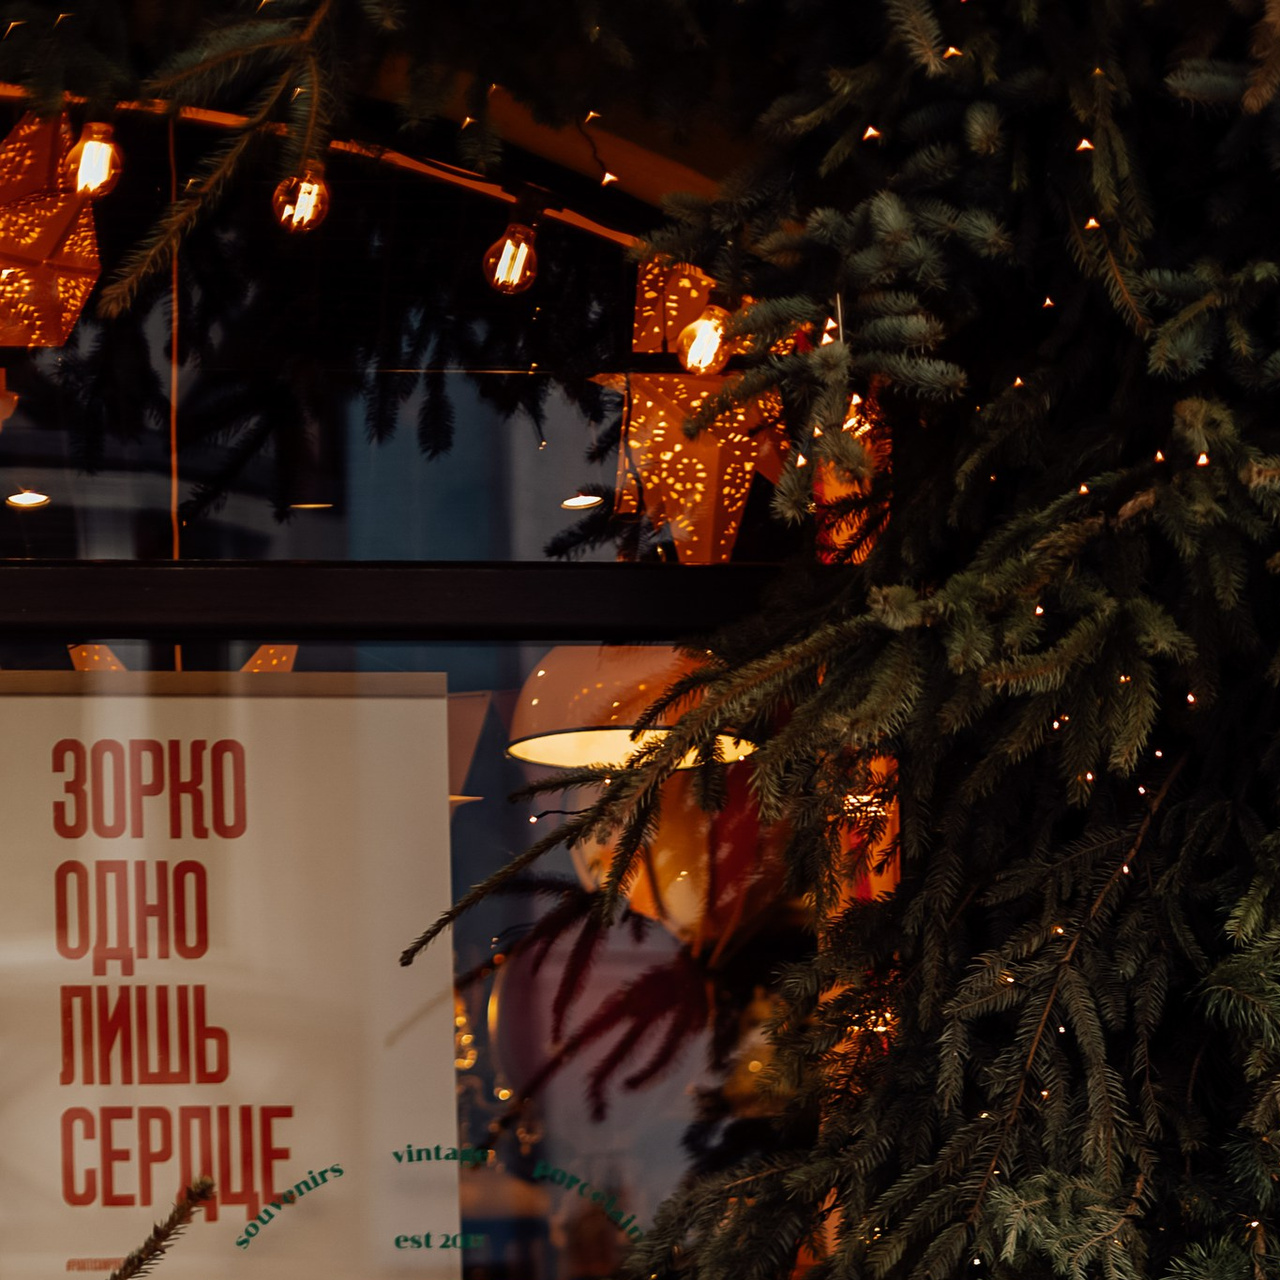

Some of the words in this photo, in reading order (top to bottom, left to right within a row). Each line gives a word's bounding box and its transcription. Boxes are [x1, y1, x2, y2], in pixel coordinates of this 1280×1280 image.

[51, 738, 248, 840] ЗОРКО
[55, 859, 209, 977] ОДНО
[60, 984, 230, 1086] ЛИШЬ
[61, 1105, 295, 1223] СЕРДЦЕ
[235, 1163, 344, 1250] souvenirs
[392, 1144, 488, 1168] vintage
[532, 1159, 643, 1242] porcelain
[394, 1231, 433, 1249] est
